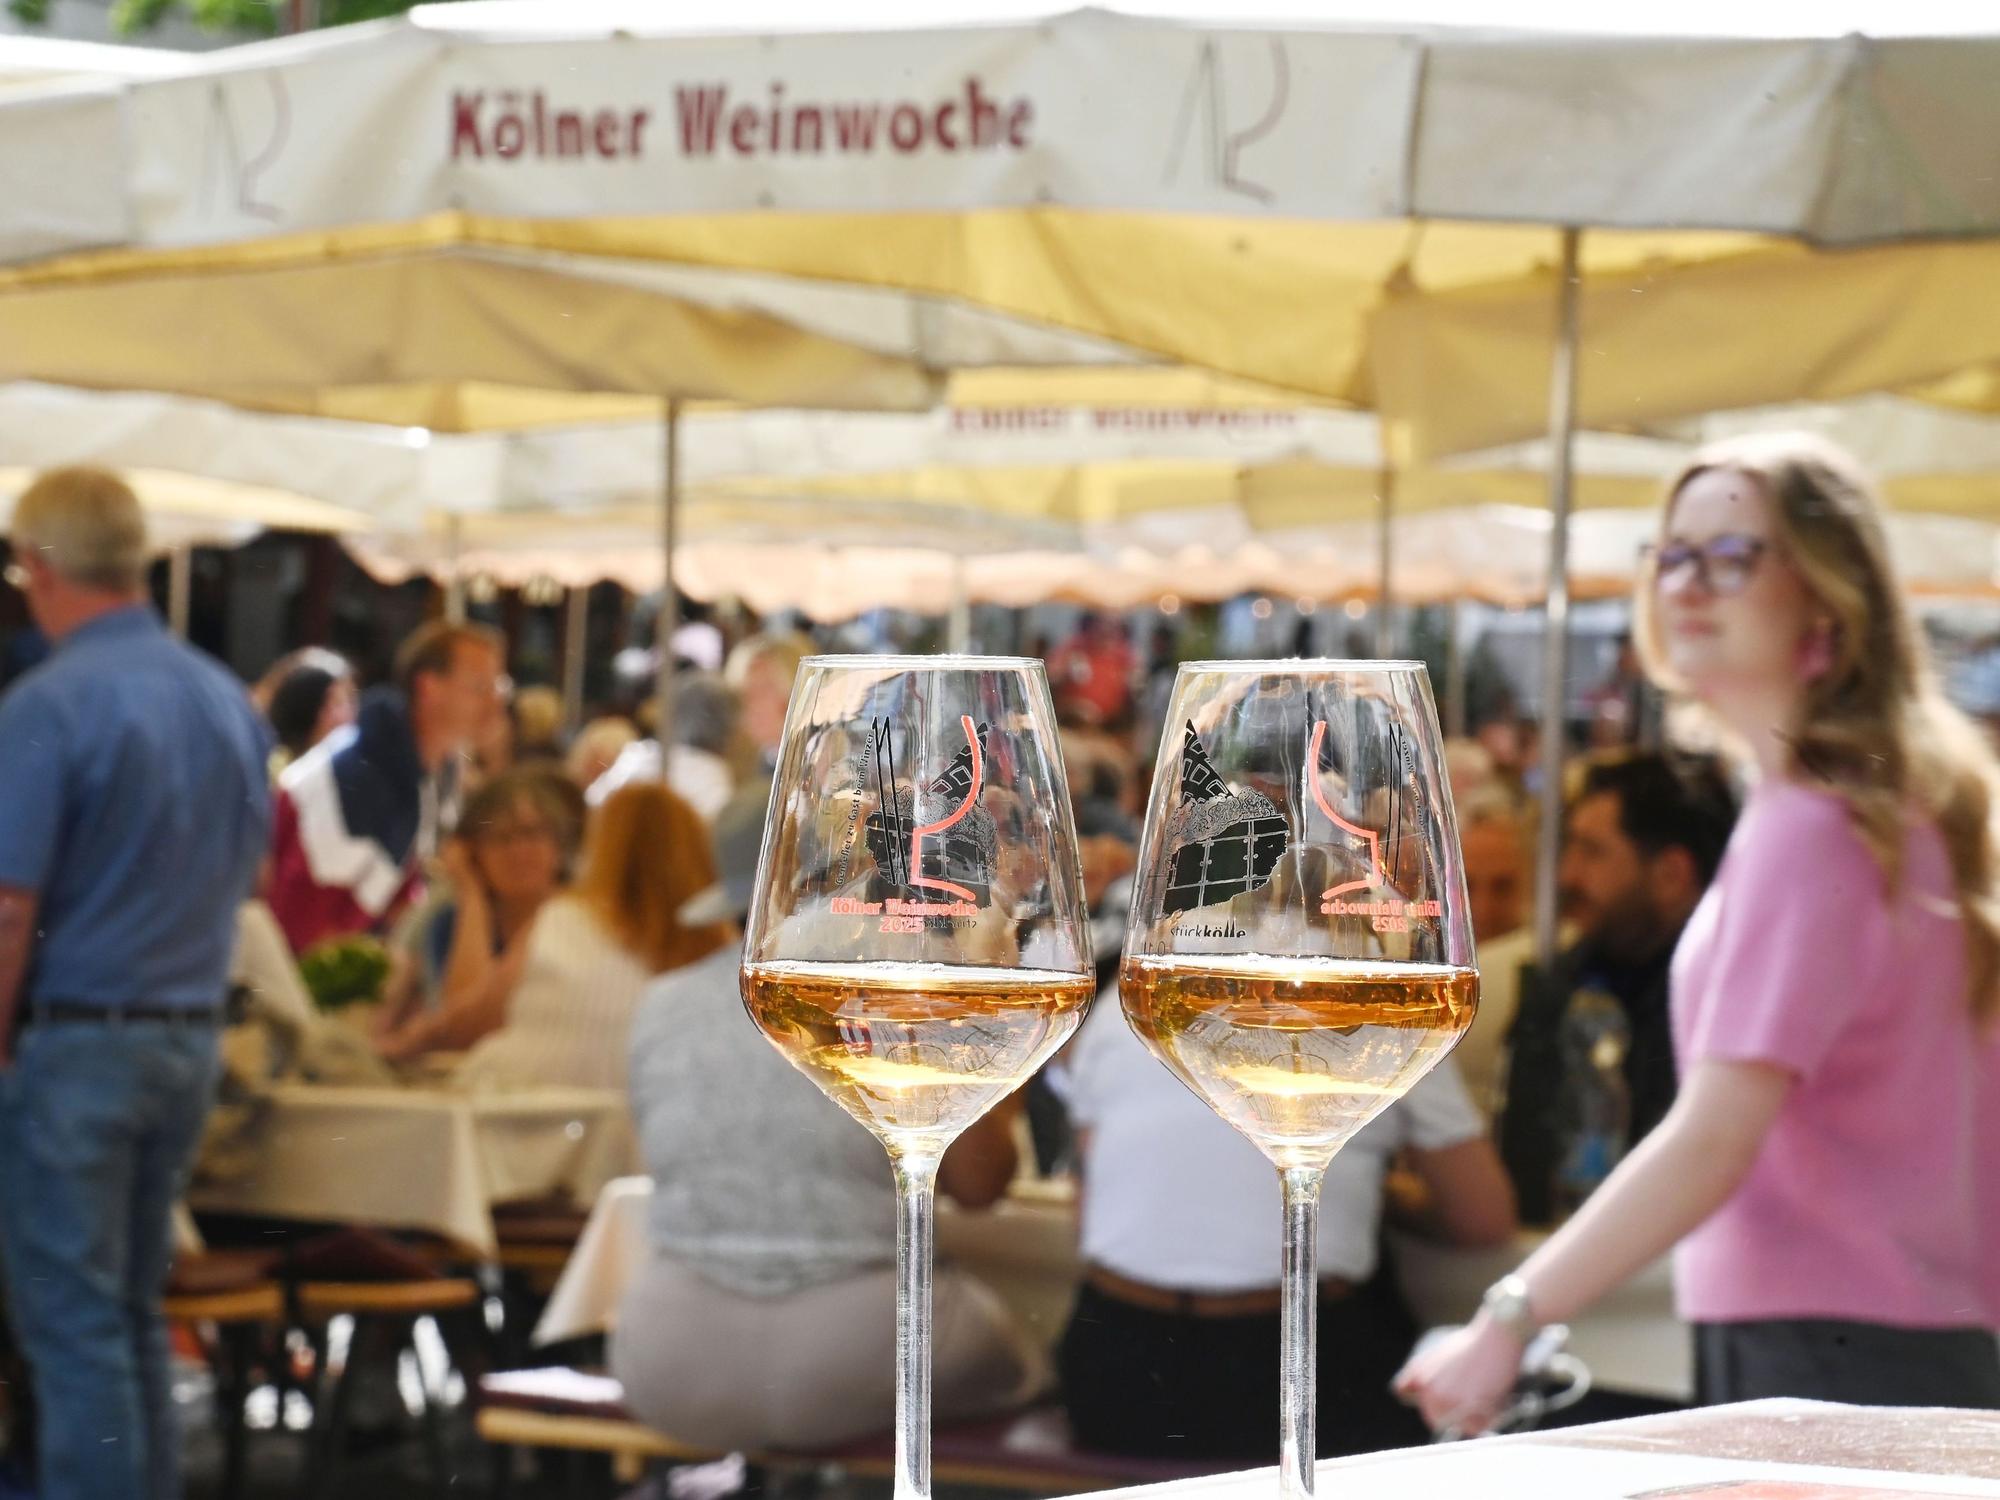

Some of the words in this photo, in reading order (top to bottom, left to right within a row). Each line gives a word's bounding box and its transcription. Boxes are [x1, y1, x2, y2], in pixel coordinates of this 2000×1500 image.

[452, 91, 649, 159] Kölner
[676, 76, 1034, 153] Weinwoche
[860, 734, 875, 767] Winzer
[831, 897, 882, 915] Kölner
[884, 898, 978, 916] Weinwoche
[879, 917, 925, 933] 2025
